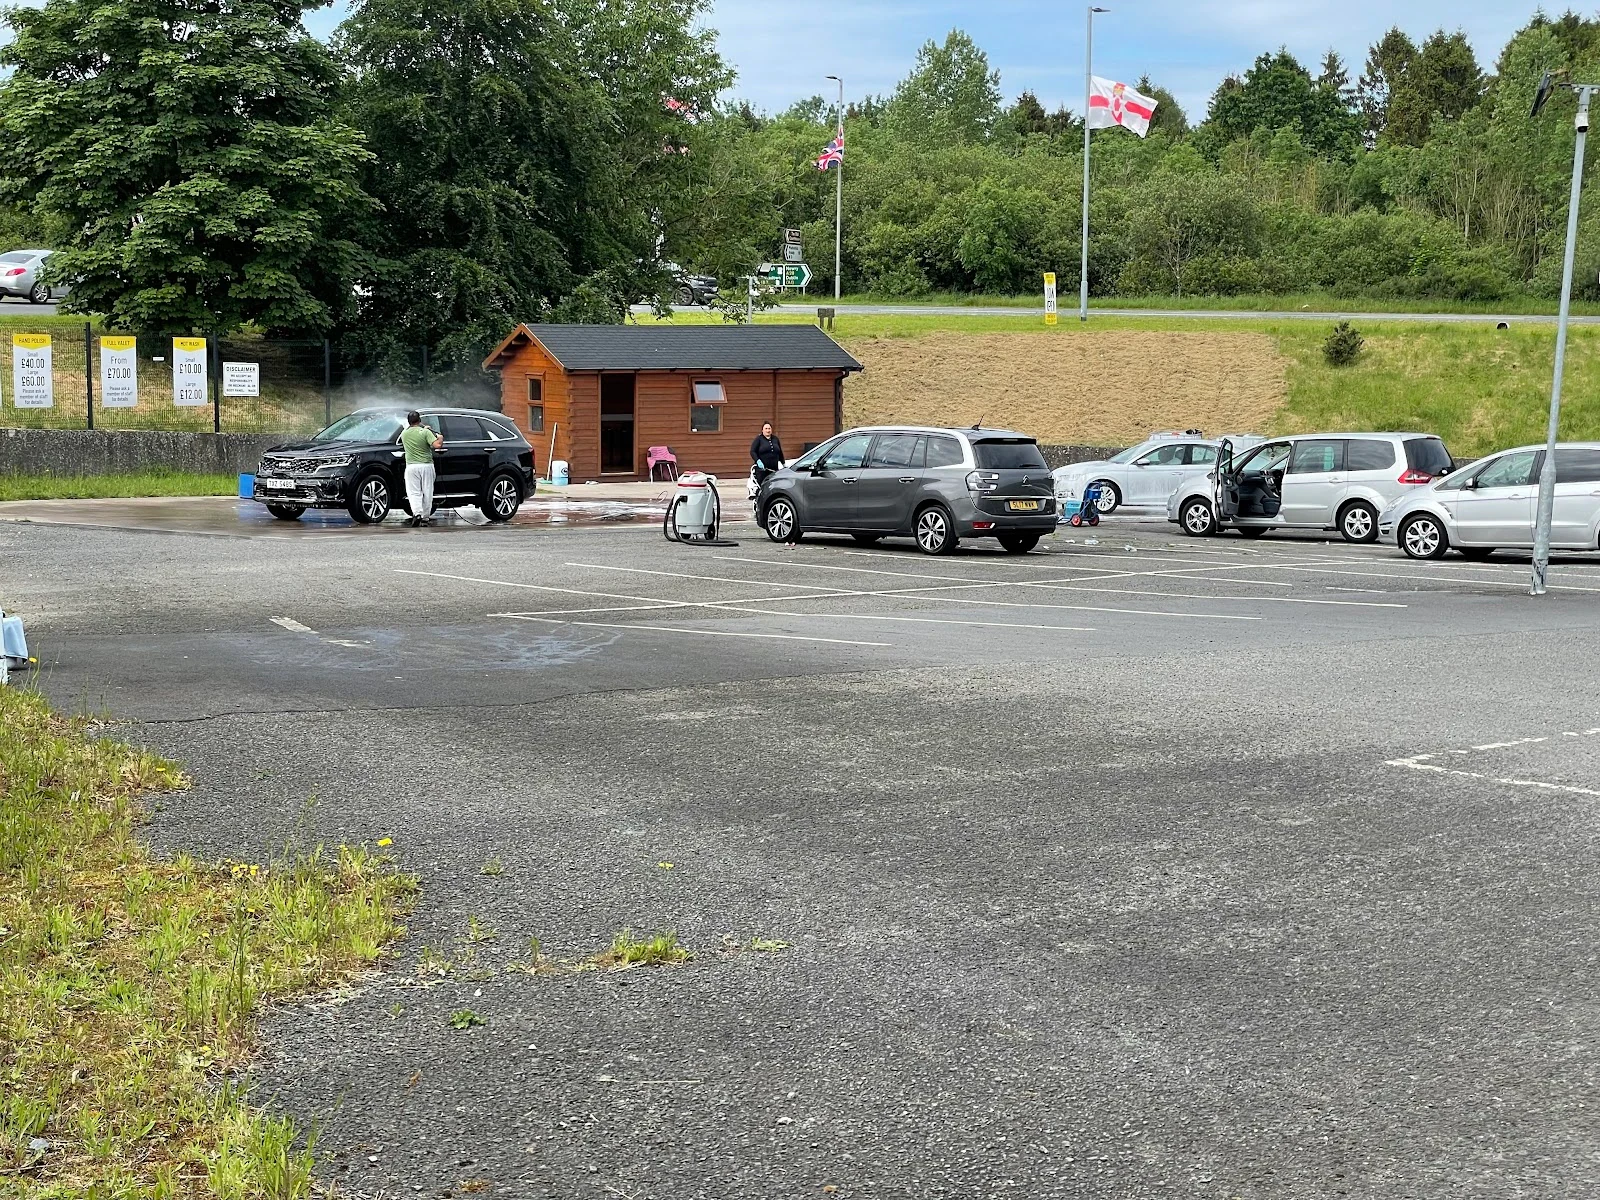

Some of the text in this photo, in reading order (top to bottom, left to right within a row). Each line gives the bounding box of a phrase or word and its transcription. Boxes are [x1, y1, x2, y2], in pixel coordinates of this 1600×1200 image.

[21, 358, 45, 369] £40.00
[110, 356, 127, 364] From
[107, 368, 131, 379] £70.00
[180, 363, 202, 374] £10.00
[21, 376, 45, 387] £60.00
[180, 390, 202, 400] £12.00
